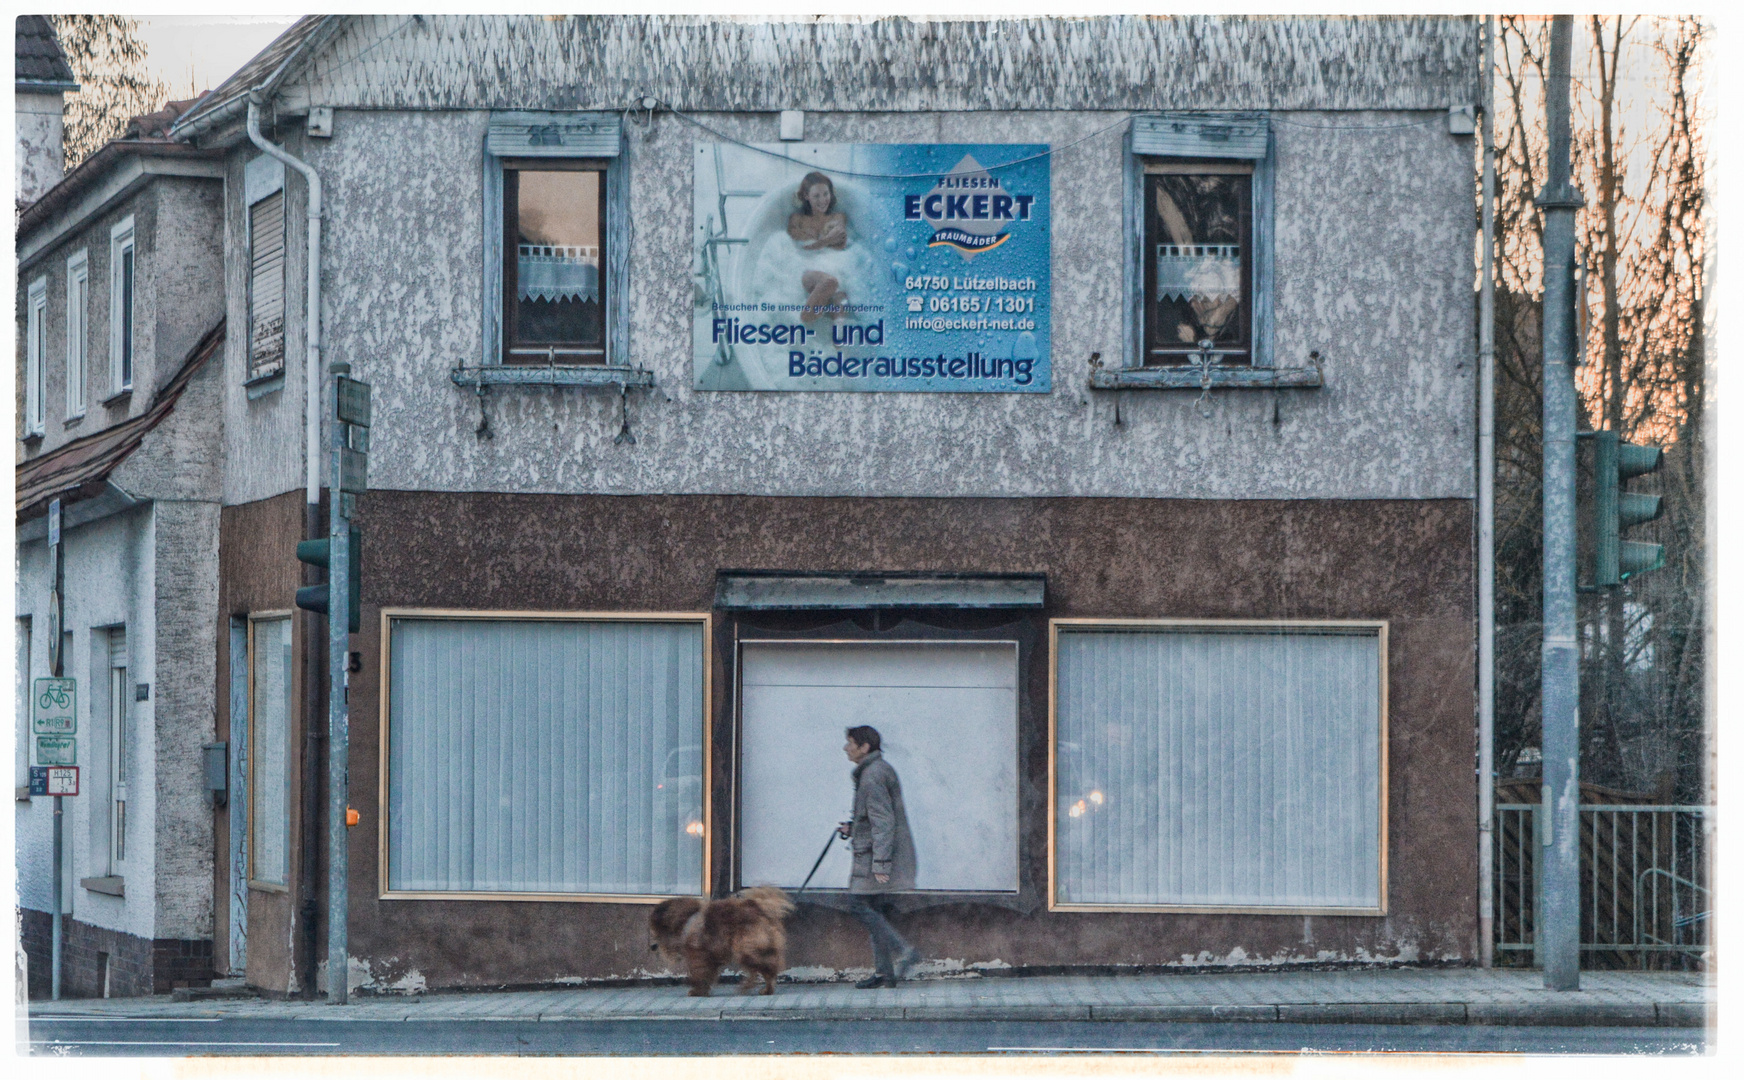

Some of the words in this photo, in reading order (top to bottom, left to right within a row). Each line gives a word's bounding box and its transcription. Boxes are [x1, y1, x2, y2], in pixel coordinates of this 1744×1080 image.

[938, 177, 1000, 190] FLIESEN
[904, 194, 1036, 221] ECKERT
[935, 231, 997, 246] TRAUMBÄDER
[904, 276, 949, 291] 64750
[953, 276, 1036, 291] Lützelbach
[711, 302, 759, 312] Besuchen
[761, 302, 776, 312] Sie
[778, 303, 811, 312] unsere
[813, 302, 841, 314] große
[842, 303, 885, 312] moderne
[929, 296, 981, 313] 06165
[984, 297, 992, 313] /
[995, 297, 1035, 313] 1301
[711, 316, 817, 346] Fliesen-
[831, 319, 885, 347] und
[904, 316, 1036, 333] info@eckert-net.de
[787, 350, 1035, 386] Bäderausstellung
